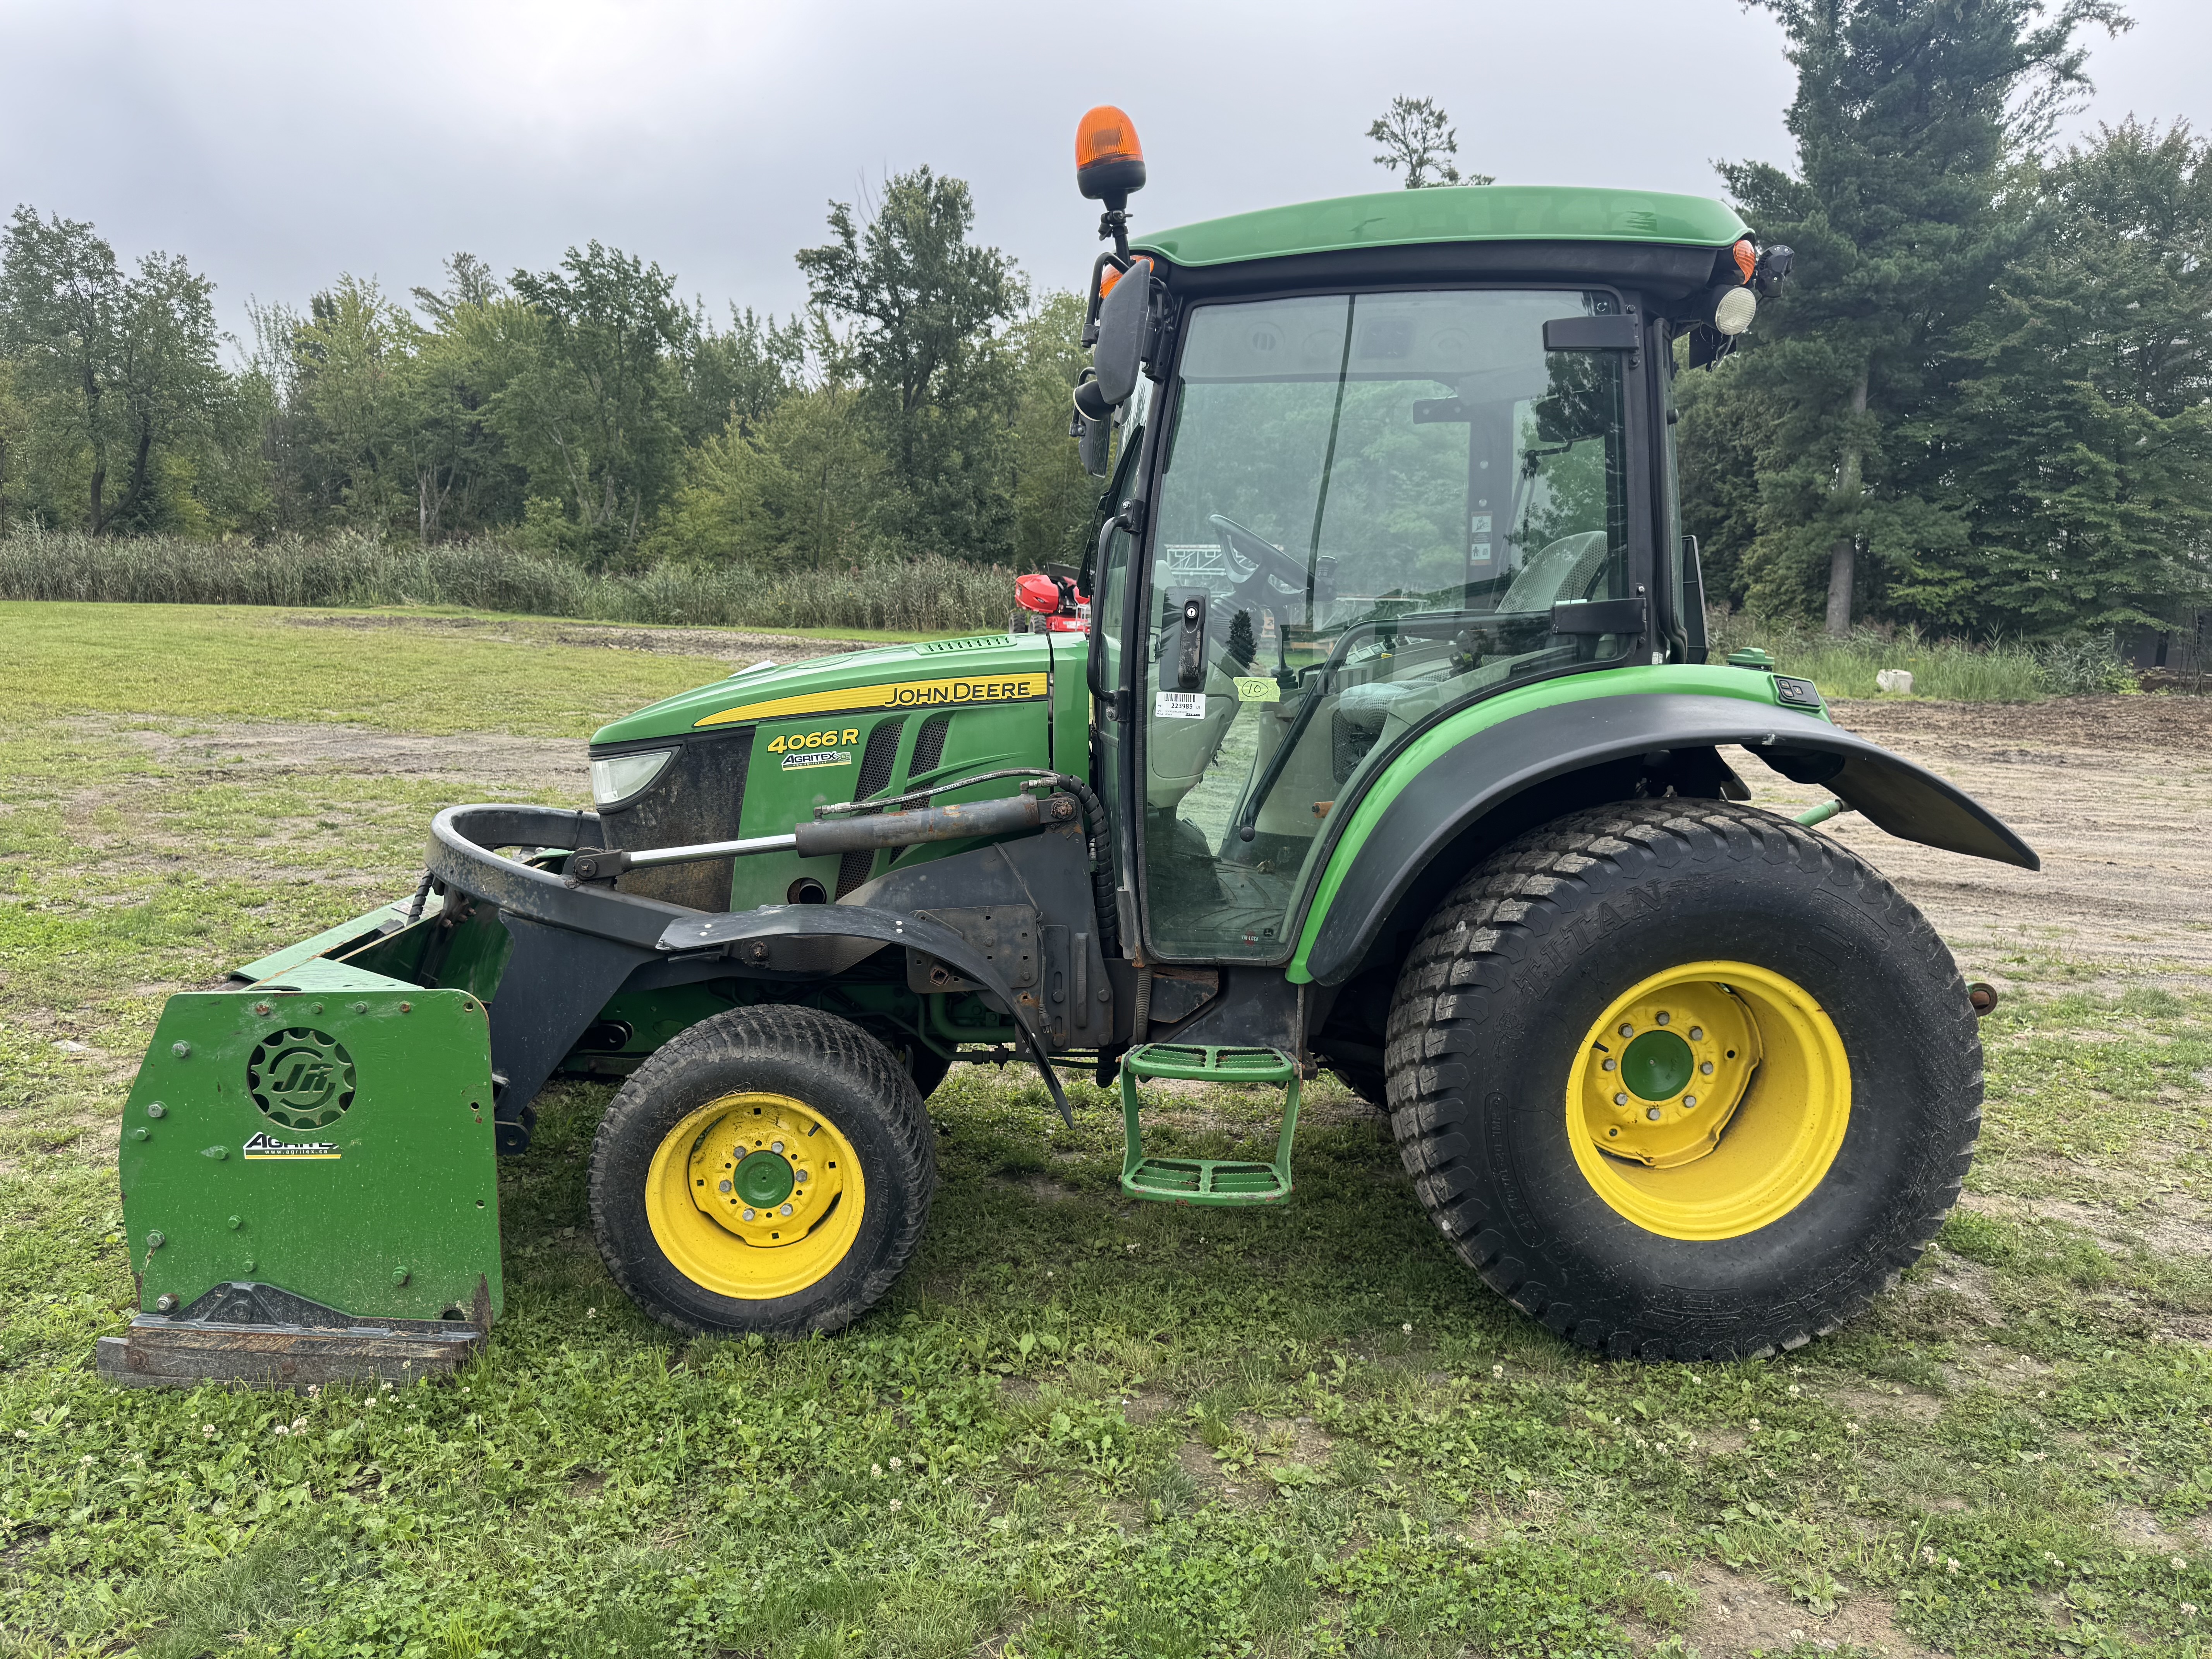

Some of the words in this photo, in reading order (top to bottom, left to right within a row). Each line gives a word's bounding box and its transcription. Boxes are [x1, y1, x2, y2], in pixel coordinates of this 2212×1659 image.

[885, 687, 948, 705] JOHN
[953, 682, 1031, 699] DEERE
[1249, 684, 1262, 694] 10
[783, 753, 836, 764] AGRITEX
[1514, 877, 1668, 1003] TITAN
